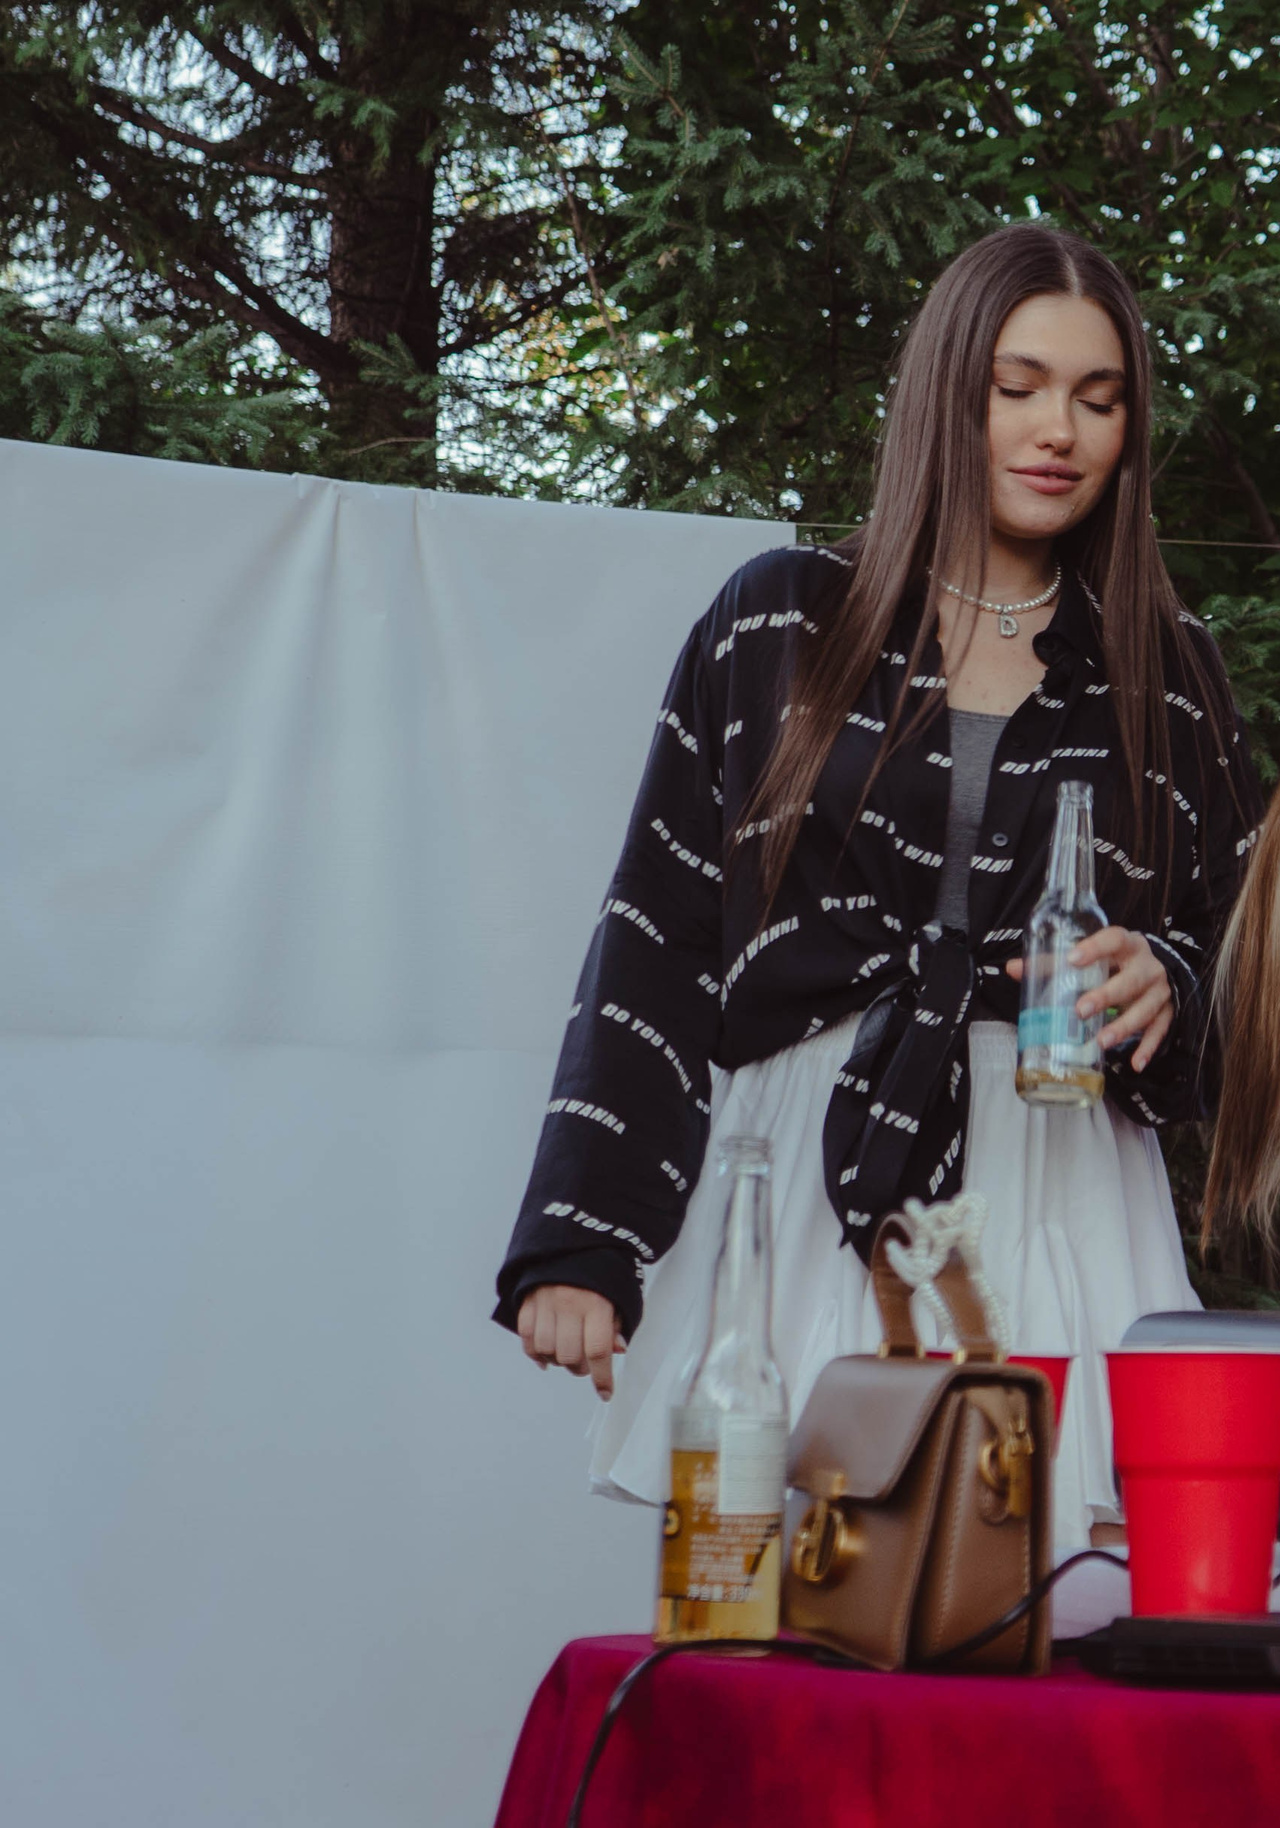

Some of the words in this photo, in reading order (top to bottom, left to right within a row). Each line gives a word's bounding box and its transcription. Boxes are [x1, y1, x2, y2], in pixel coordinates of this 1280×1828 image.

[999, 761, 1031, 775] DO
[651, 818, 671, 841] DO
[669, 840, 702, 868] YOU
[746, 916, 799, 961] WANNA
[601, 1003, 631, 1023] DO
[630, 1018, 665, 1047] YOU
[663, 1044, 692, 1094] WANNA
[564, 1100, 626, 1135] WANNA
[572, 1211, 614, 1232] YOU
